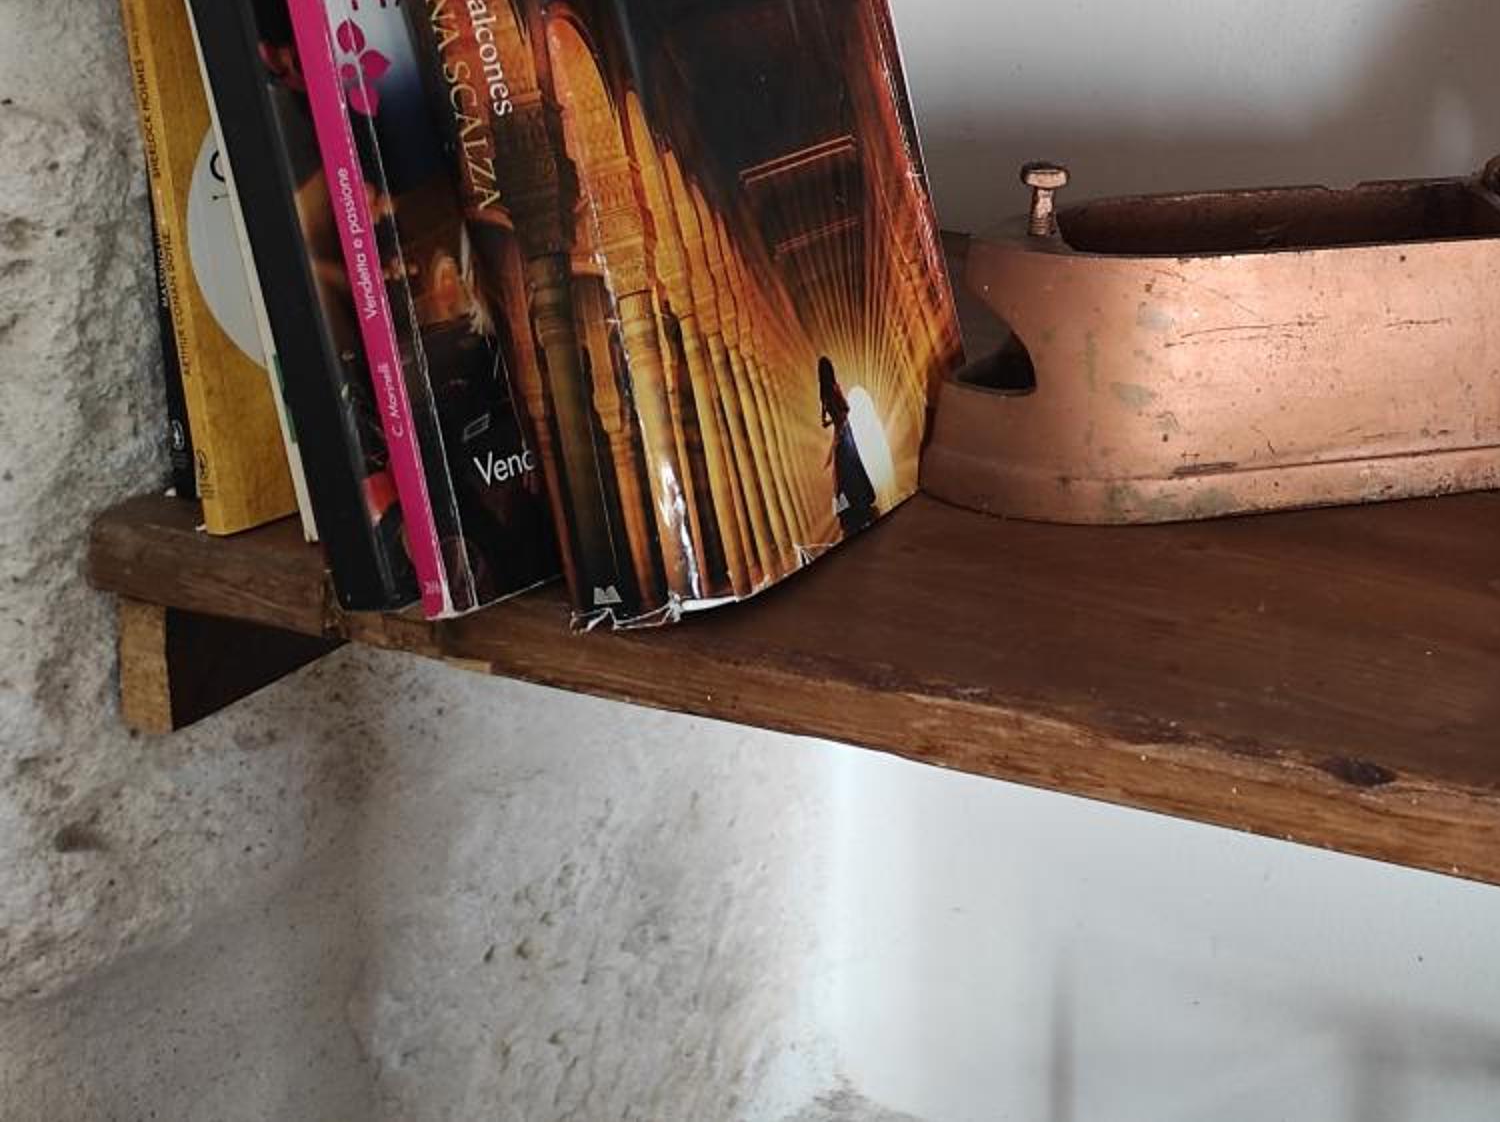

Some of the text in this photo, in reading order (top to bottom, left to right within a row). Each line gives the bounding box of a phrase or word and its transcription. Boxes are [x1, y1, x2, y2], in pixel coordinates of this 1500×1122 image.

[134, 58, 161, 179] SHERLOCK HOLMES
[443, 60, 502, 210] SCALZA
[336, 167, 366, 235] passione
[168, 276, 184, 328] CONAN
[356, 250, 380, 319] Vendetta
